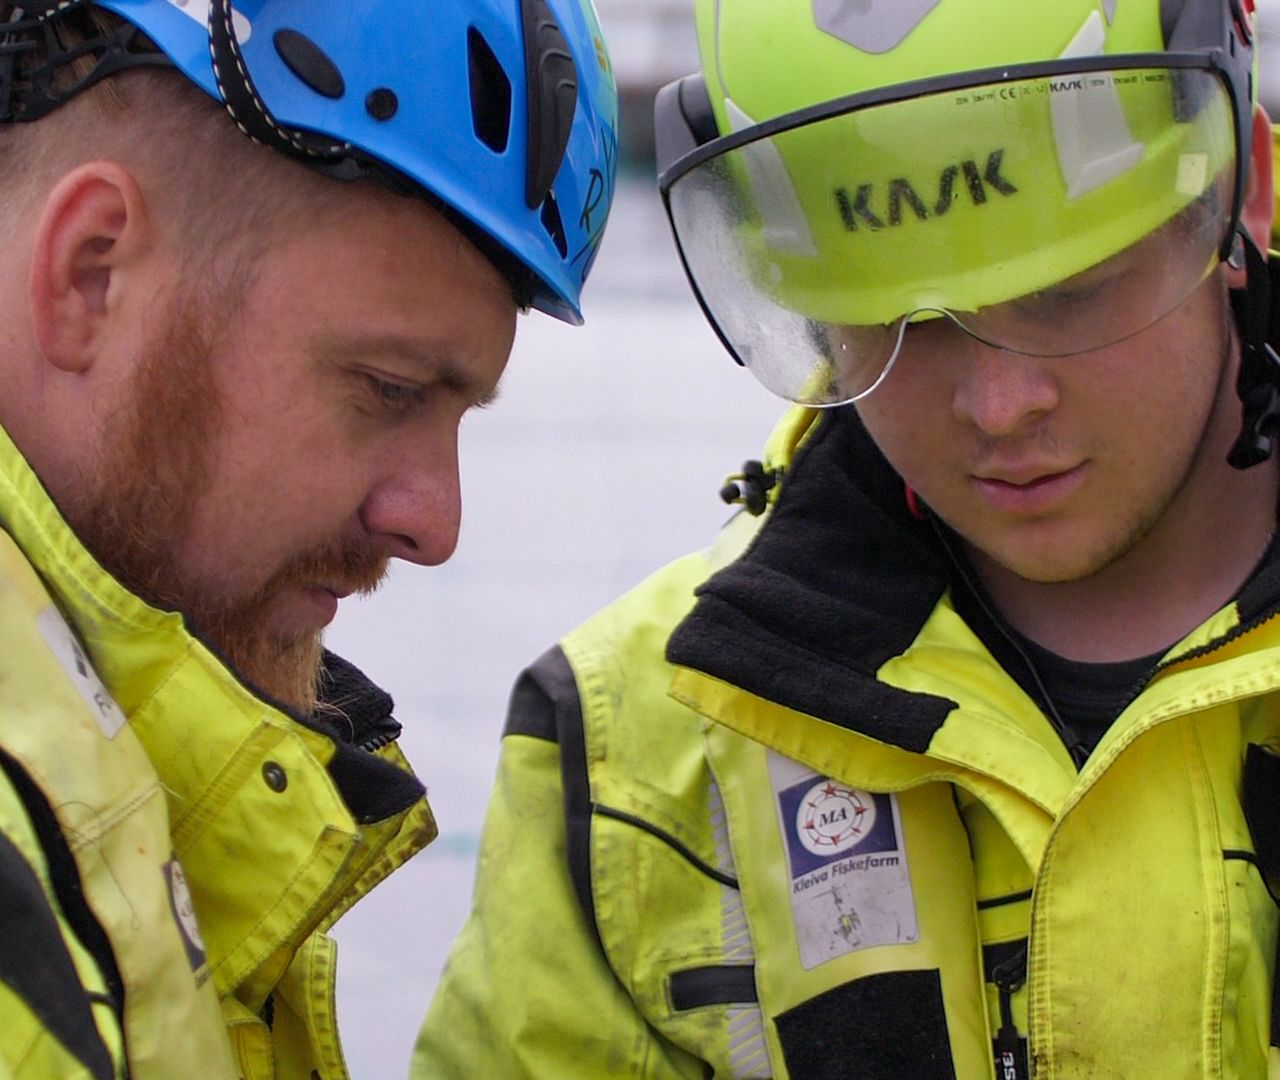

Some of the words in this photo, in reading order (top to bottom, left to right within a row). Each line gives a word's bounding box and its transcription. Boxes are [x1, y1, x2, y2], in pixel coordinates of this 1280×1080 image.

[835, 149, 1018, 231] KASK
[819, 807, 848, 828] MA
[793, 870, 828, 894] Kleiva
[832, 855, 899, 878] Fiskefarm
